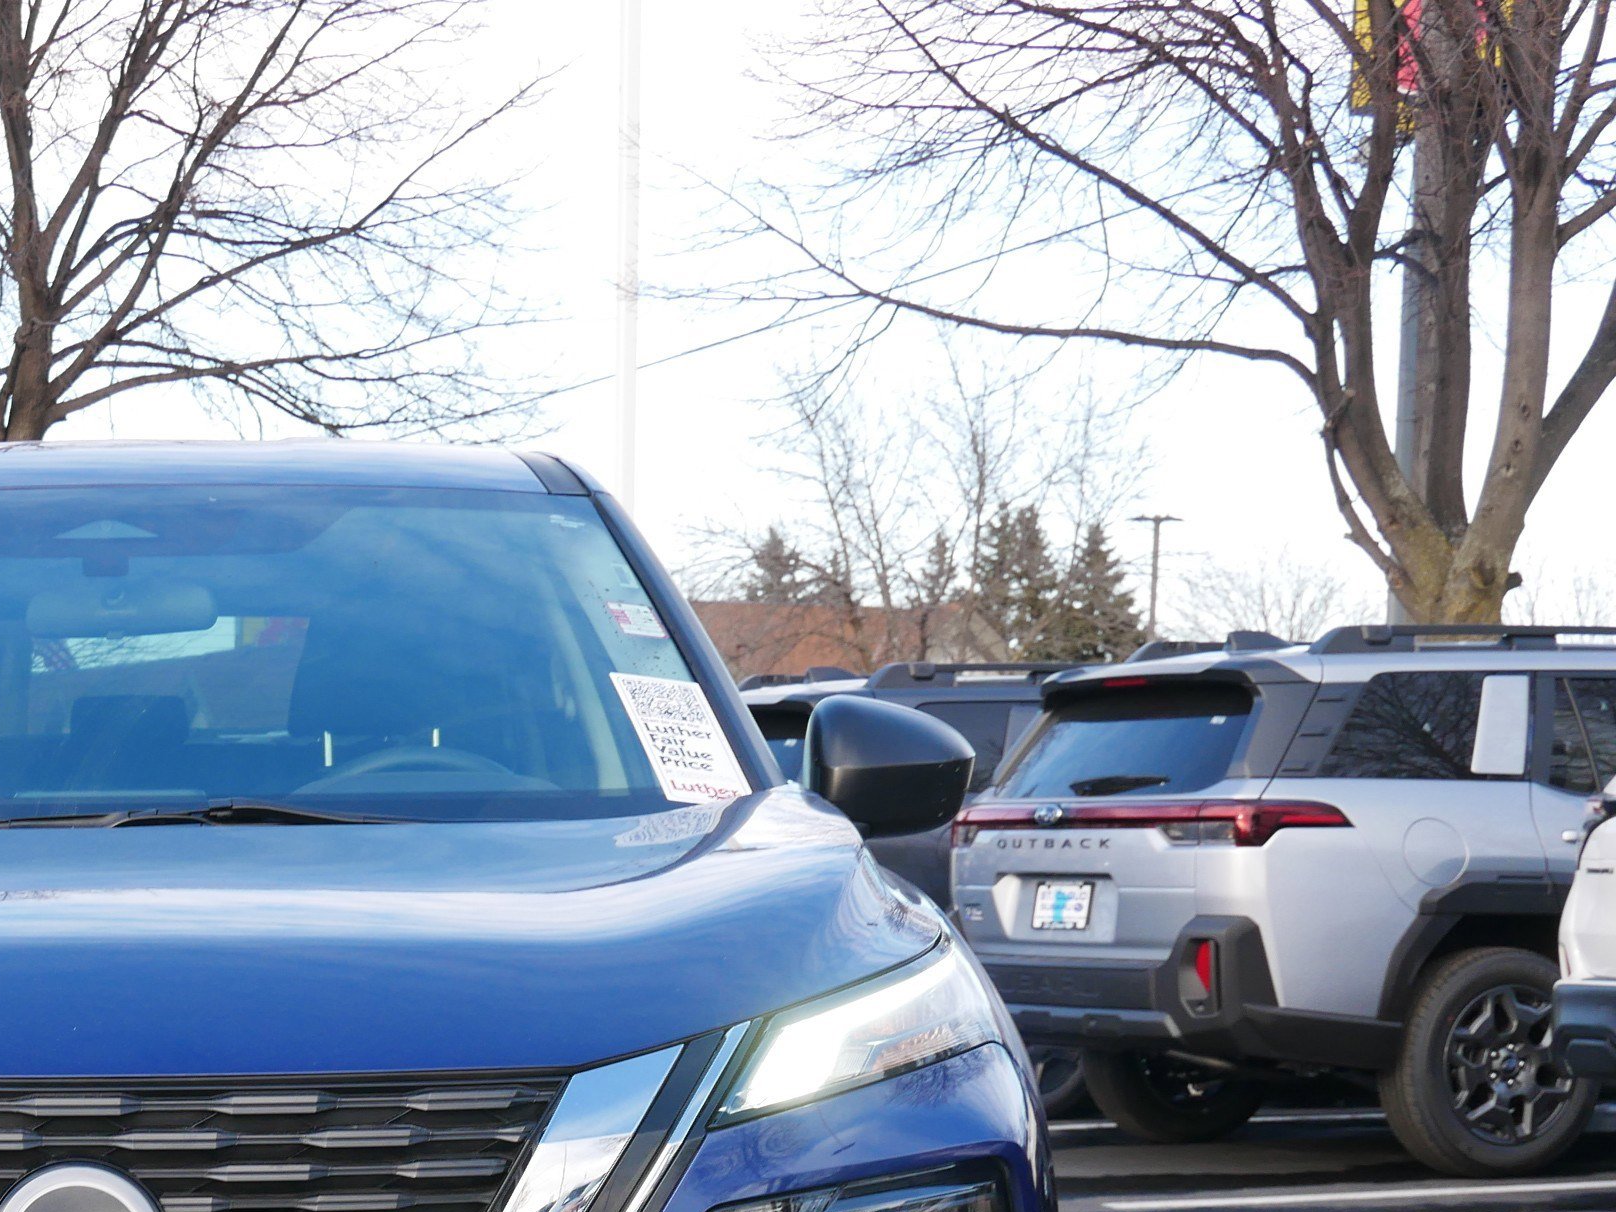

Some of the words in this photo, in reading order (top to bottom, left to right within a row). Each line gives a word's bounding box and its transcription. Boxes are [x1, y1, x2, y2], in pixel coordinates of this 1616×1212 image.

[644, 722, 712, 740] Luther
[649, 733, 686, 746] Fair
[653, 744, 714, 761] Value
[659, 755, 714, 772] Price
[670, 779, 740, 801] Luther
[996, 837, 1111, 850] OUTBACK
